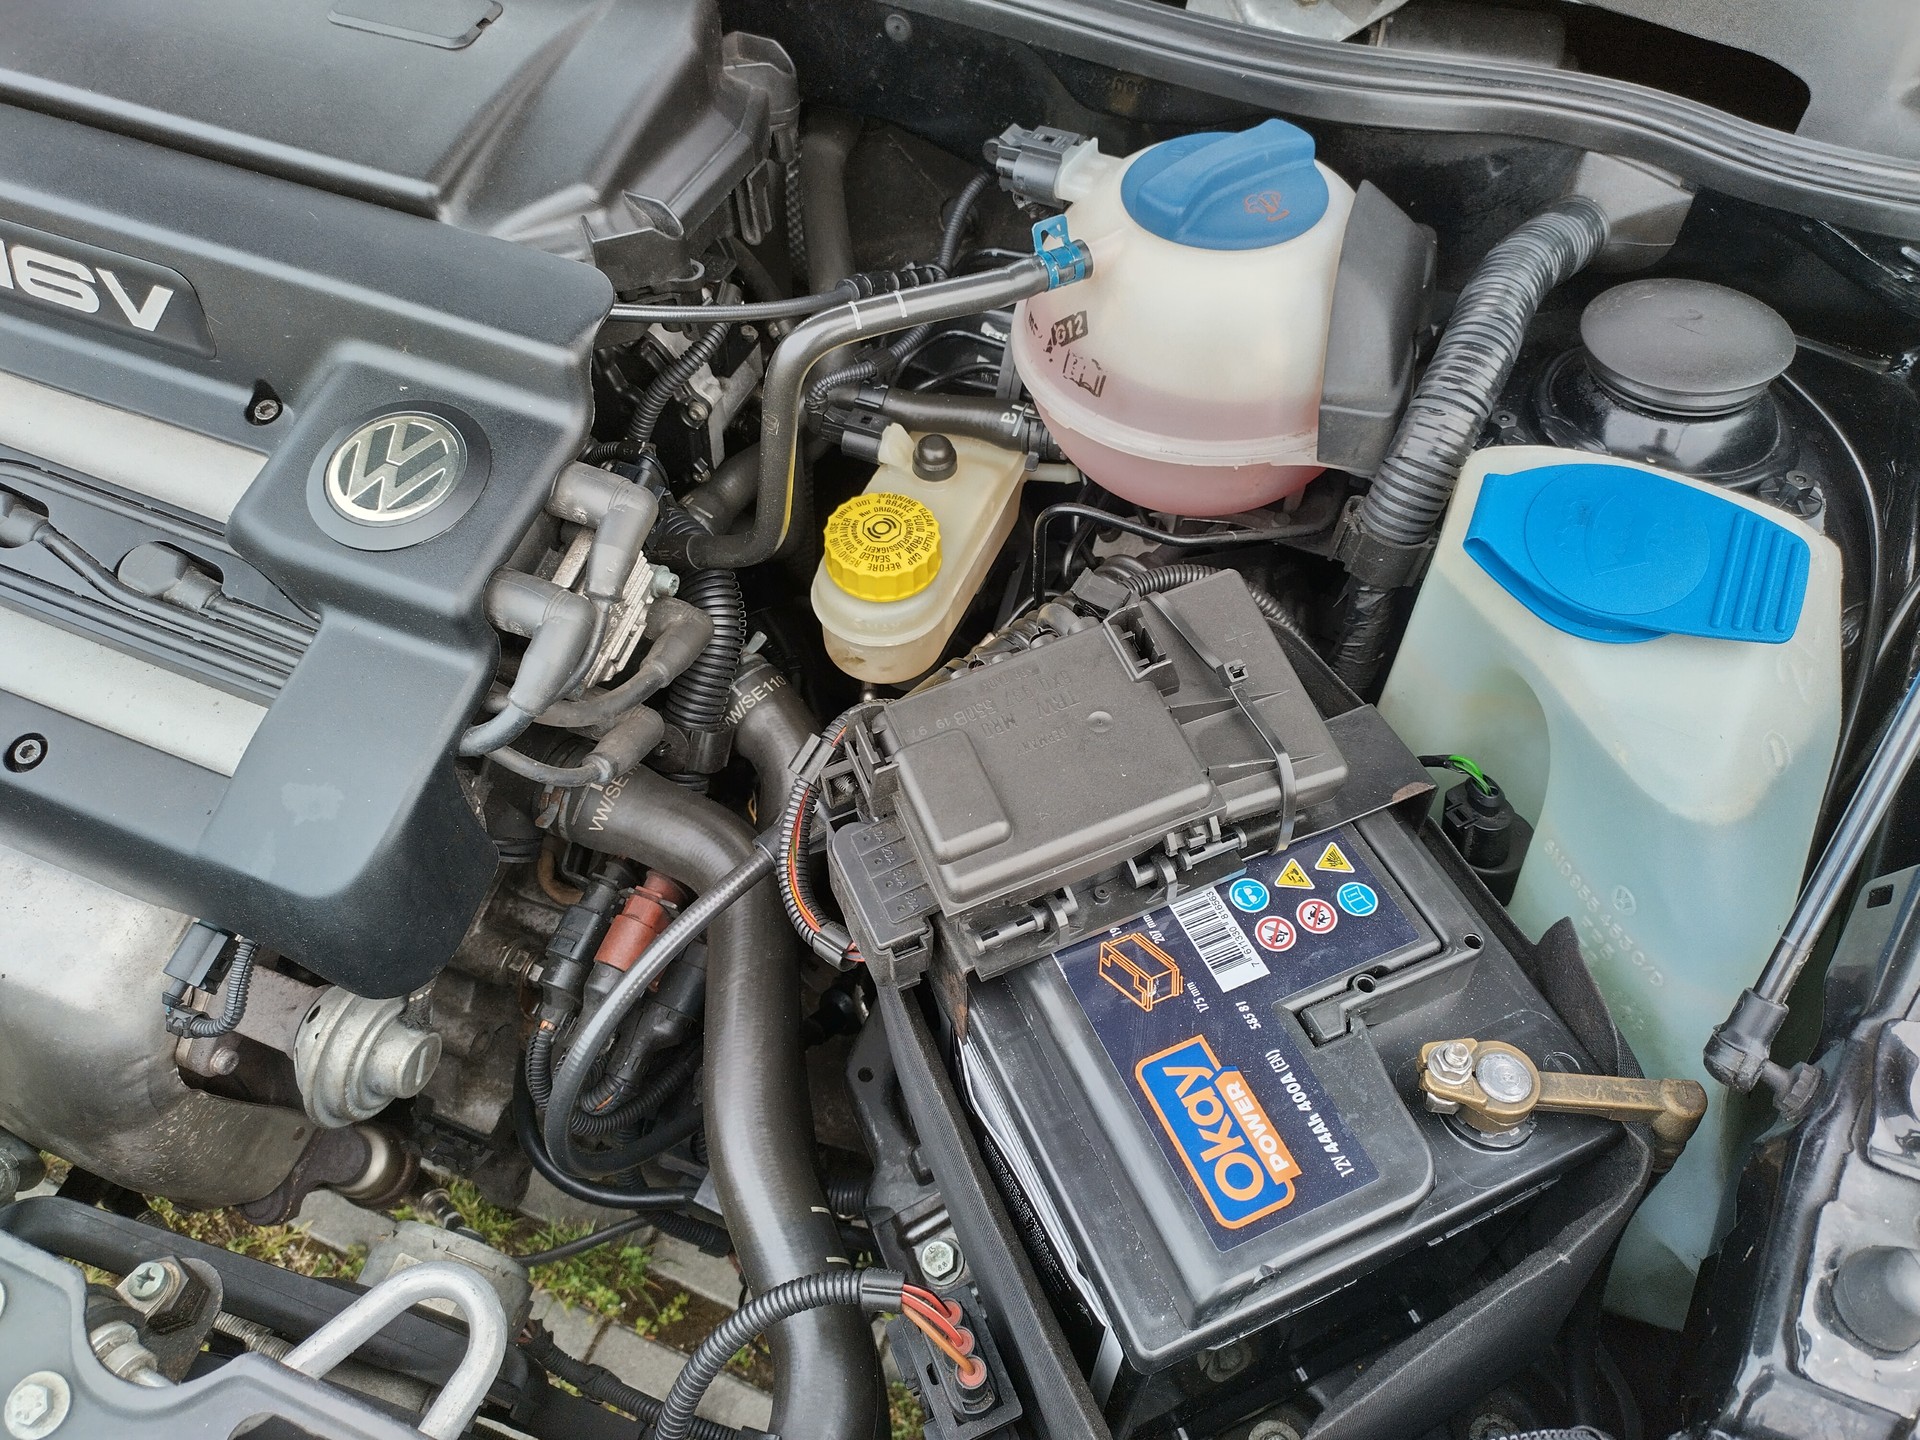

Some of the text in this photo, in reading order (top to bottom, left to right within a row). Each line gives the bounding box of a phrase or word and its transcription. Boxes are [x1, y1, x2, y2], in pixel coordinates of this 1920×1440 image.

[878, 493, 918, 507] WARNING
[885, 499, 915, 513] BRAKE
[835, 505, 853, 520] ONLY
[873, 506, 908, 520] ORIGINAL
[918, 507, 935, 527] CLEAN
[829, 521, 840, 535] USE
[850, 519, 865, 546] verwenden
[912, 515, 926, 533] FLUID
[839, 517, 858, 555] CONTAINER
[904, 535, 924, 555] FROM
[920, 530, 936, 552] FILLER
[829, 537, 862, 568] REMOVING
[859, 551, 891, 563] SEALED
[895, 551, 903, 560] A
[907, 552, 923, 566] CAP
[867, 561, 902, 572] BEFORE
[1206, 891, 1229, 920] 816563
[1149, 930, 1166, 944] 207
[1229, 926, 1252, 955] 611330
[1186, 981, 1210, 1013] 175 mm
[1235, 1001, 1262, 1030] 585 81
[1265, 1049, 1355, 1178] 12V 44Ah 400A (EN)
[1162, 1066, 1265, 1201] Okay
[1226, 1080, 1290, 1172] POWER
